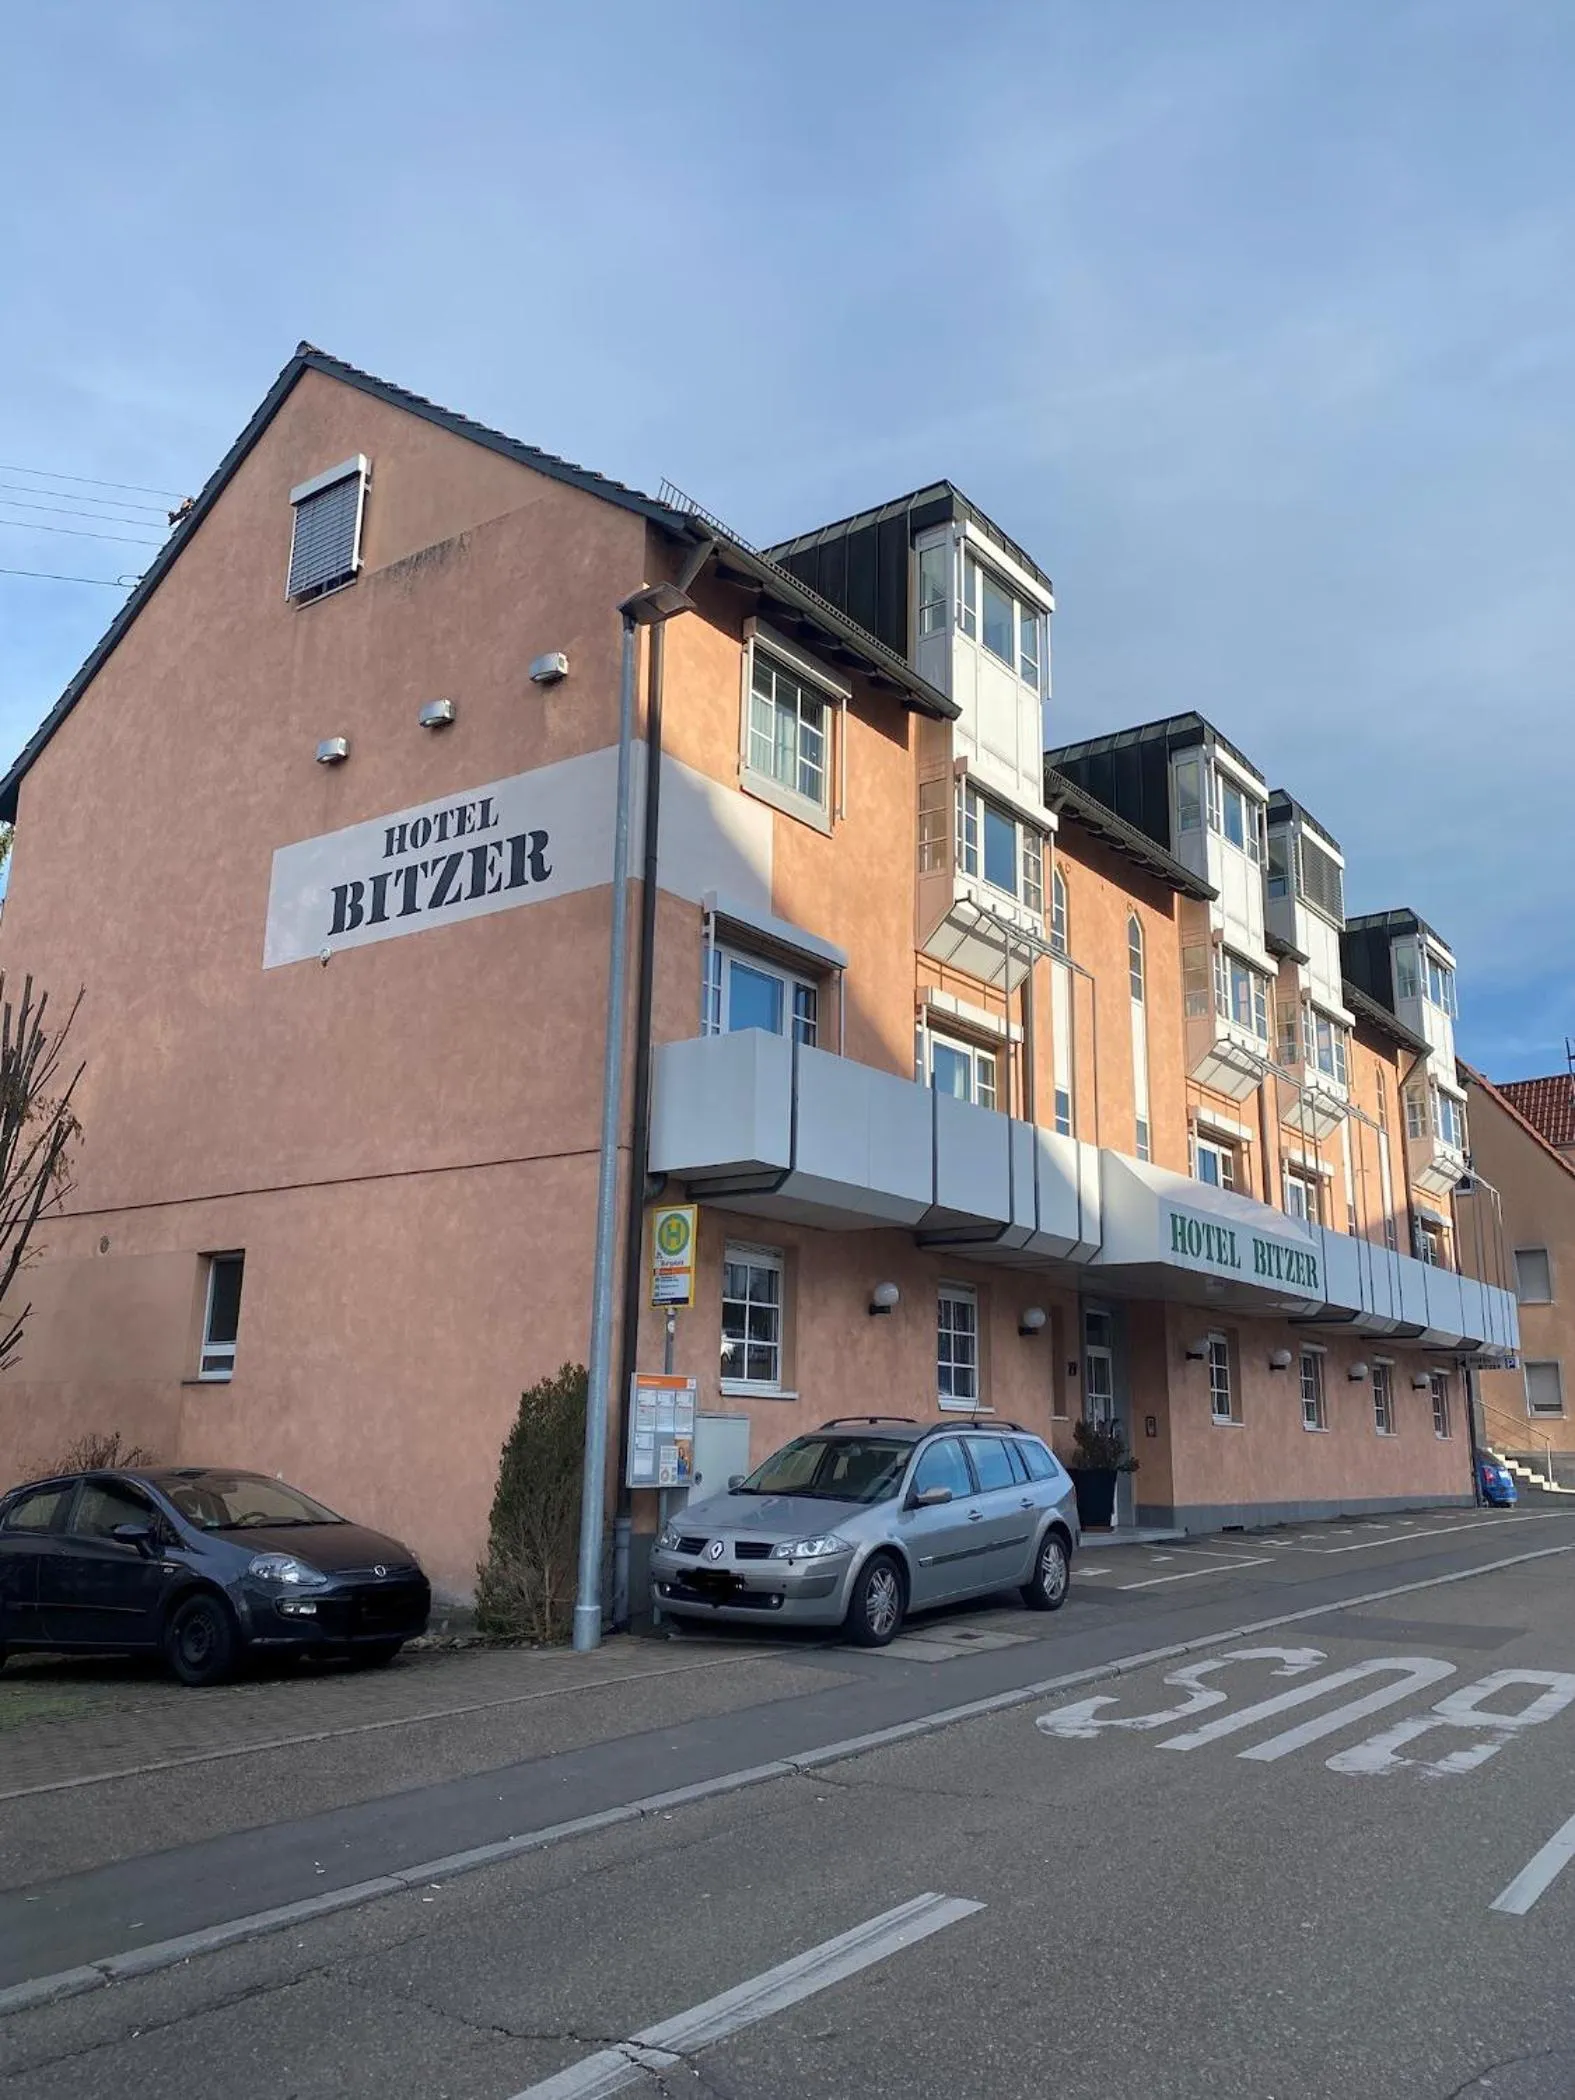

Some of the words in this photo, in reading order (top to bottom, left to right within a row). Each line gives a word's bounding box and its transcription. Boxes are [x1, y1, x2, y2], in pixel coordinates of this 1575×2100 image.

[382, 797, 499, 859] HOTEL
[327, 830, 553, 936] BITZER
[666, 1221, 681, 1247] H
[1170, 1213, 1241, 1269] HOTEL
[1252, 1238, 1319, 1289] BITZER
[1036, 1647, 1575, 1777] BUS
